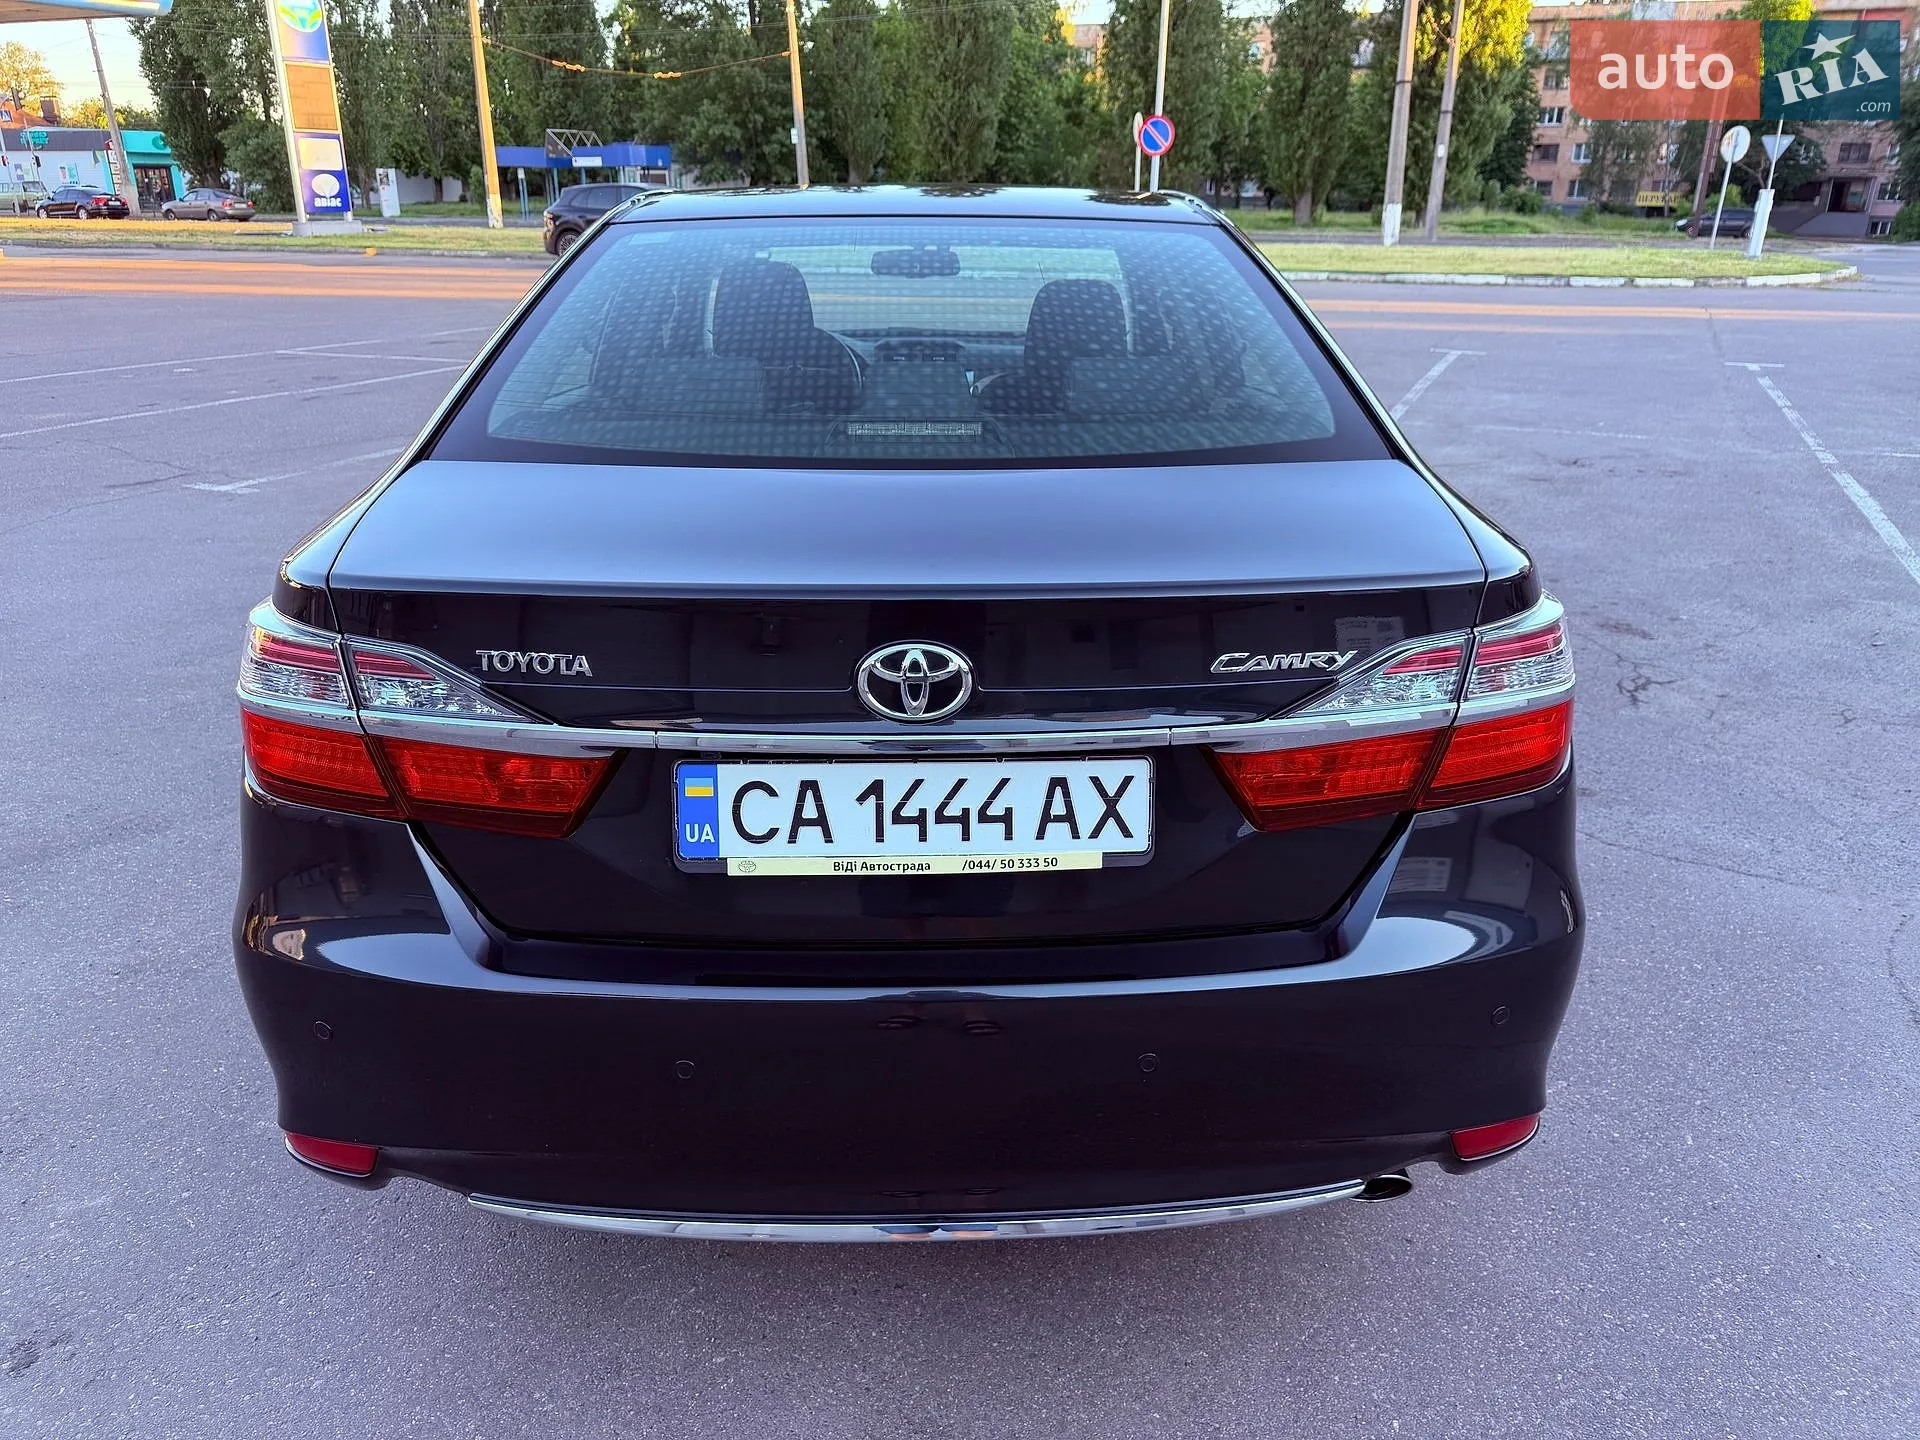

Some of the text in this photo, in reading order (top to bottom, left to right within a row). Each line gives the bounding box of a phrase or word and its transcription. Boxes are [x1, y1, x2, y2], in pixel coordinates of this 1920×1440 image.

[475, 650, 593, 677] TOYOTA
[1211, 650, 1358, 674] CAMRY
[732, 775, 1136, 845] CA 1444 AX
[685, 823, 716, 843] UA
[833, 856, 1058, 874] ВіДі Автострада /044/ 50 333 50
